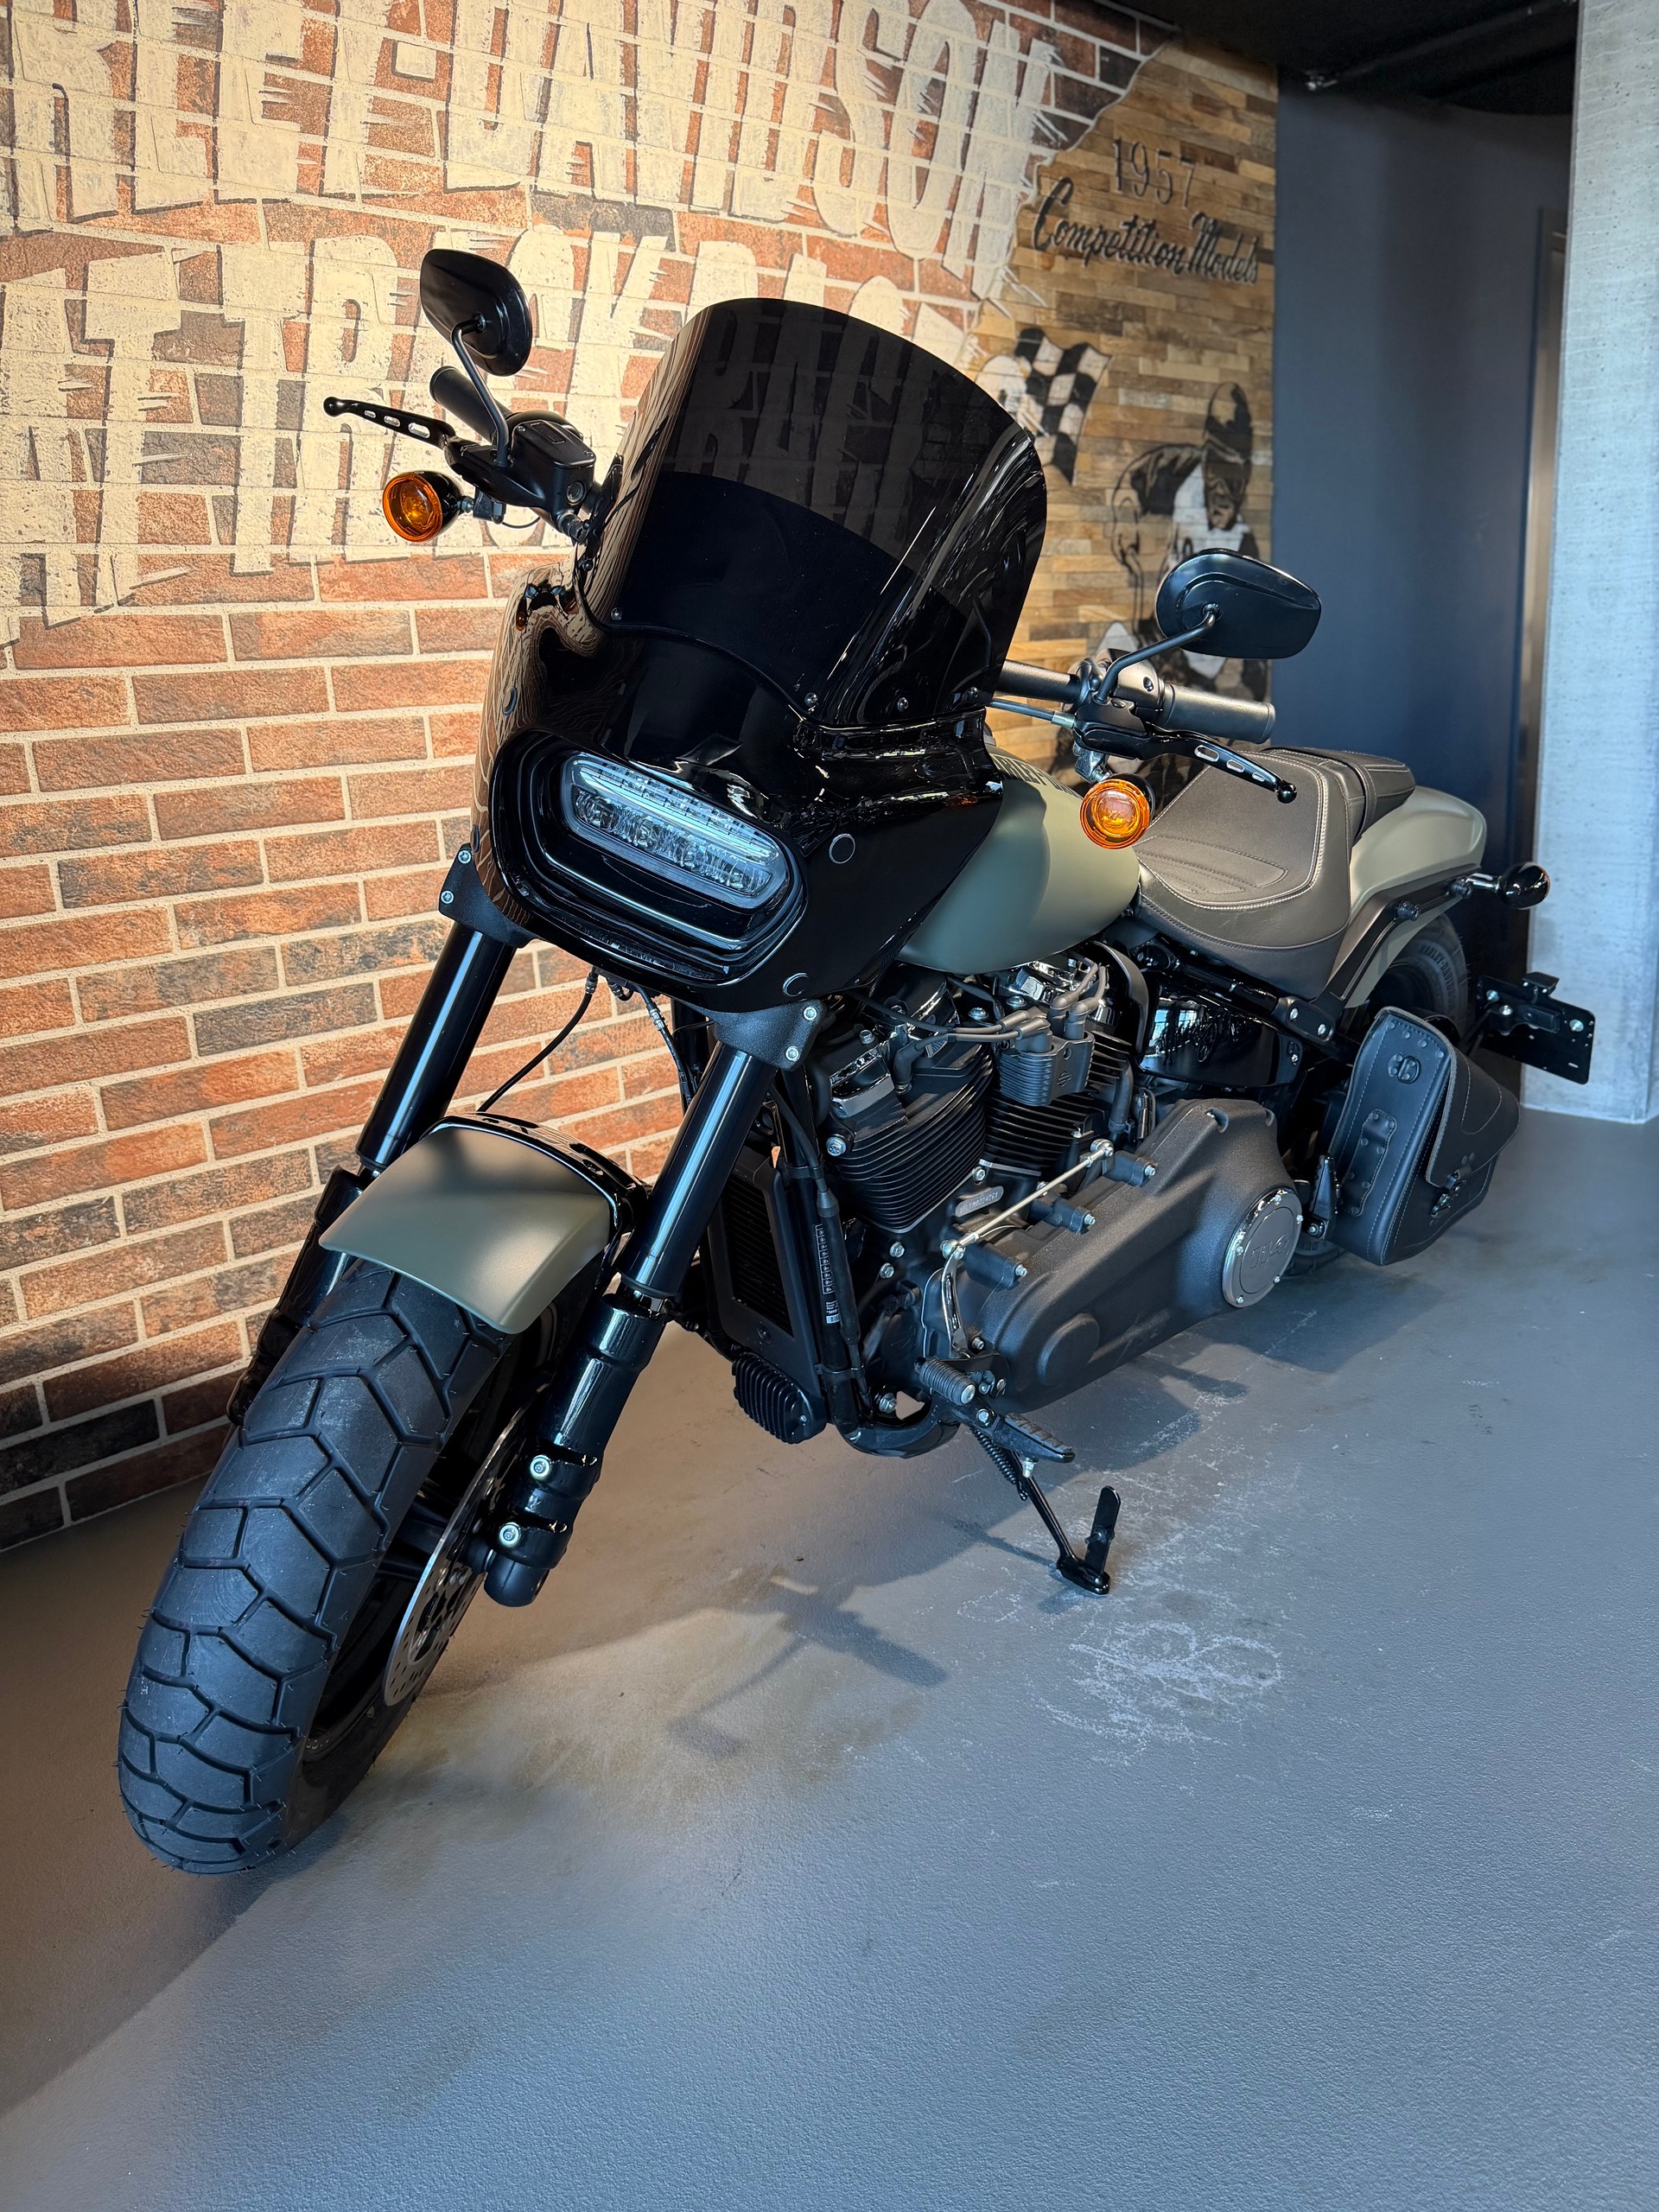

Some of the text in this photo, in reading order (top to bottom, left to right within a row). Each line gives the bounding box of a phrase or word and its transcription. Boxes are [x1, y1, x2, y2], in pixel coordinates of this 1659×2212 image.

[1114, 137, 1198, 210] 1957
[1033, 176, 1259, 285] Competition Models
